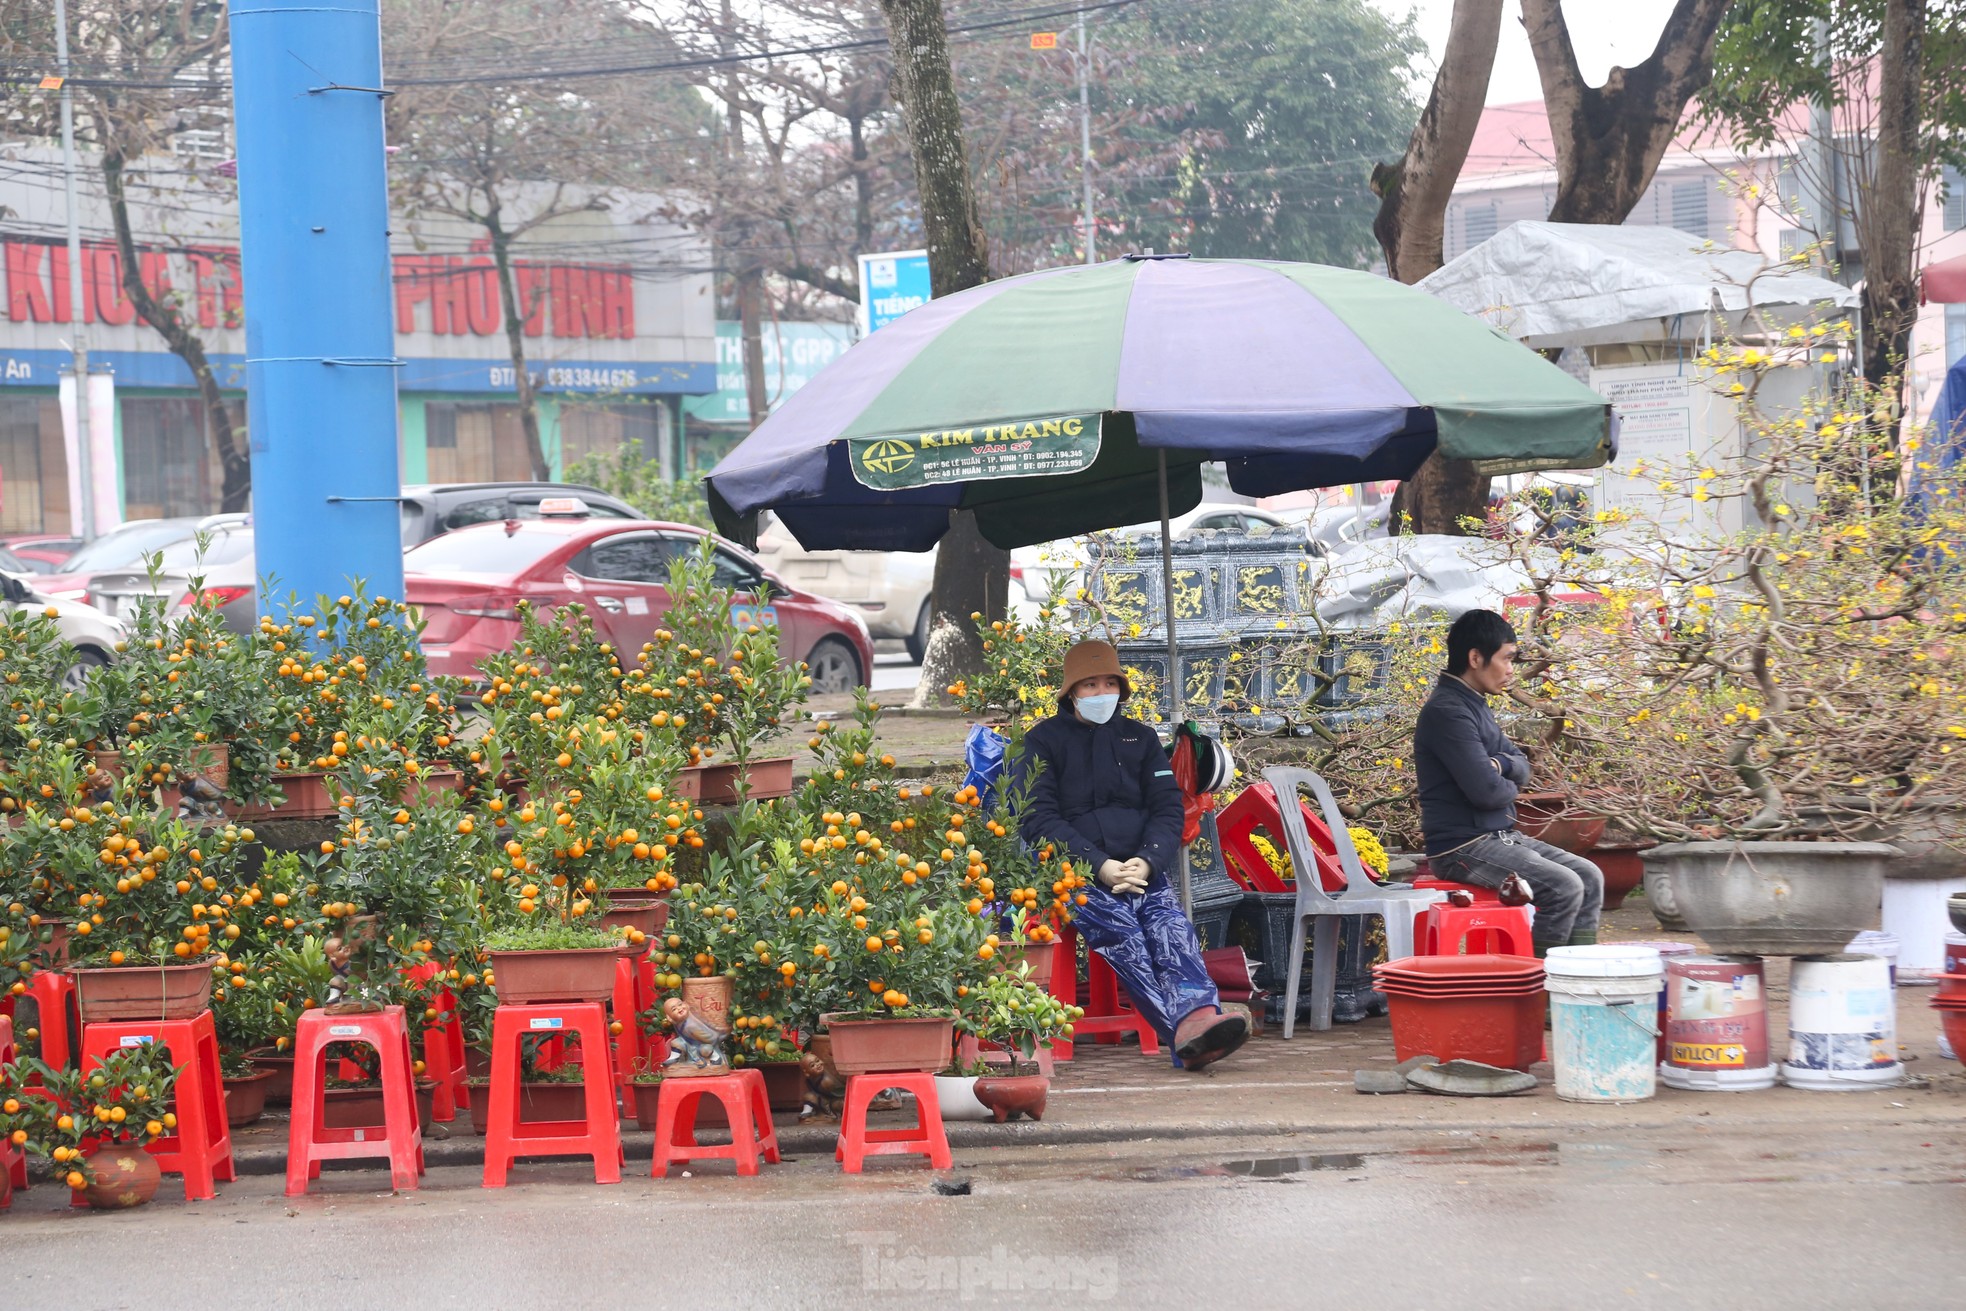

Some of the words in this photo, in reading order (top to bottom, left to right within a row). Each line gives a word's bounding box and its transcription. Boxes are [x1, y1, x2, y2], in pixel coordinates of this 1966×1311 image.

[919, 429, 974, 449] KIM
[981, 418, 1084, 443] TRANG
[951, 458, 960, 467] LÊ
[987, 456, 997, 464] TP.
[999, 454, 1017, 462] VINH
[951, 467, 961, 476] LÊ
[988, 465, 999, 473] TP.
[1000, 463, 1017, 472] VINH
[1674, 1046, 1723, 1061] JOTUN
